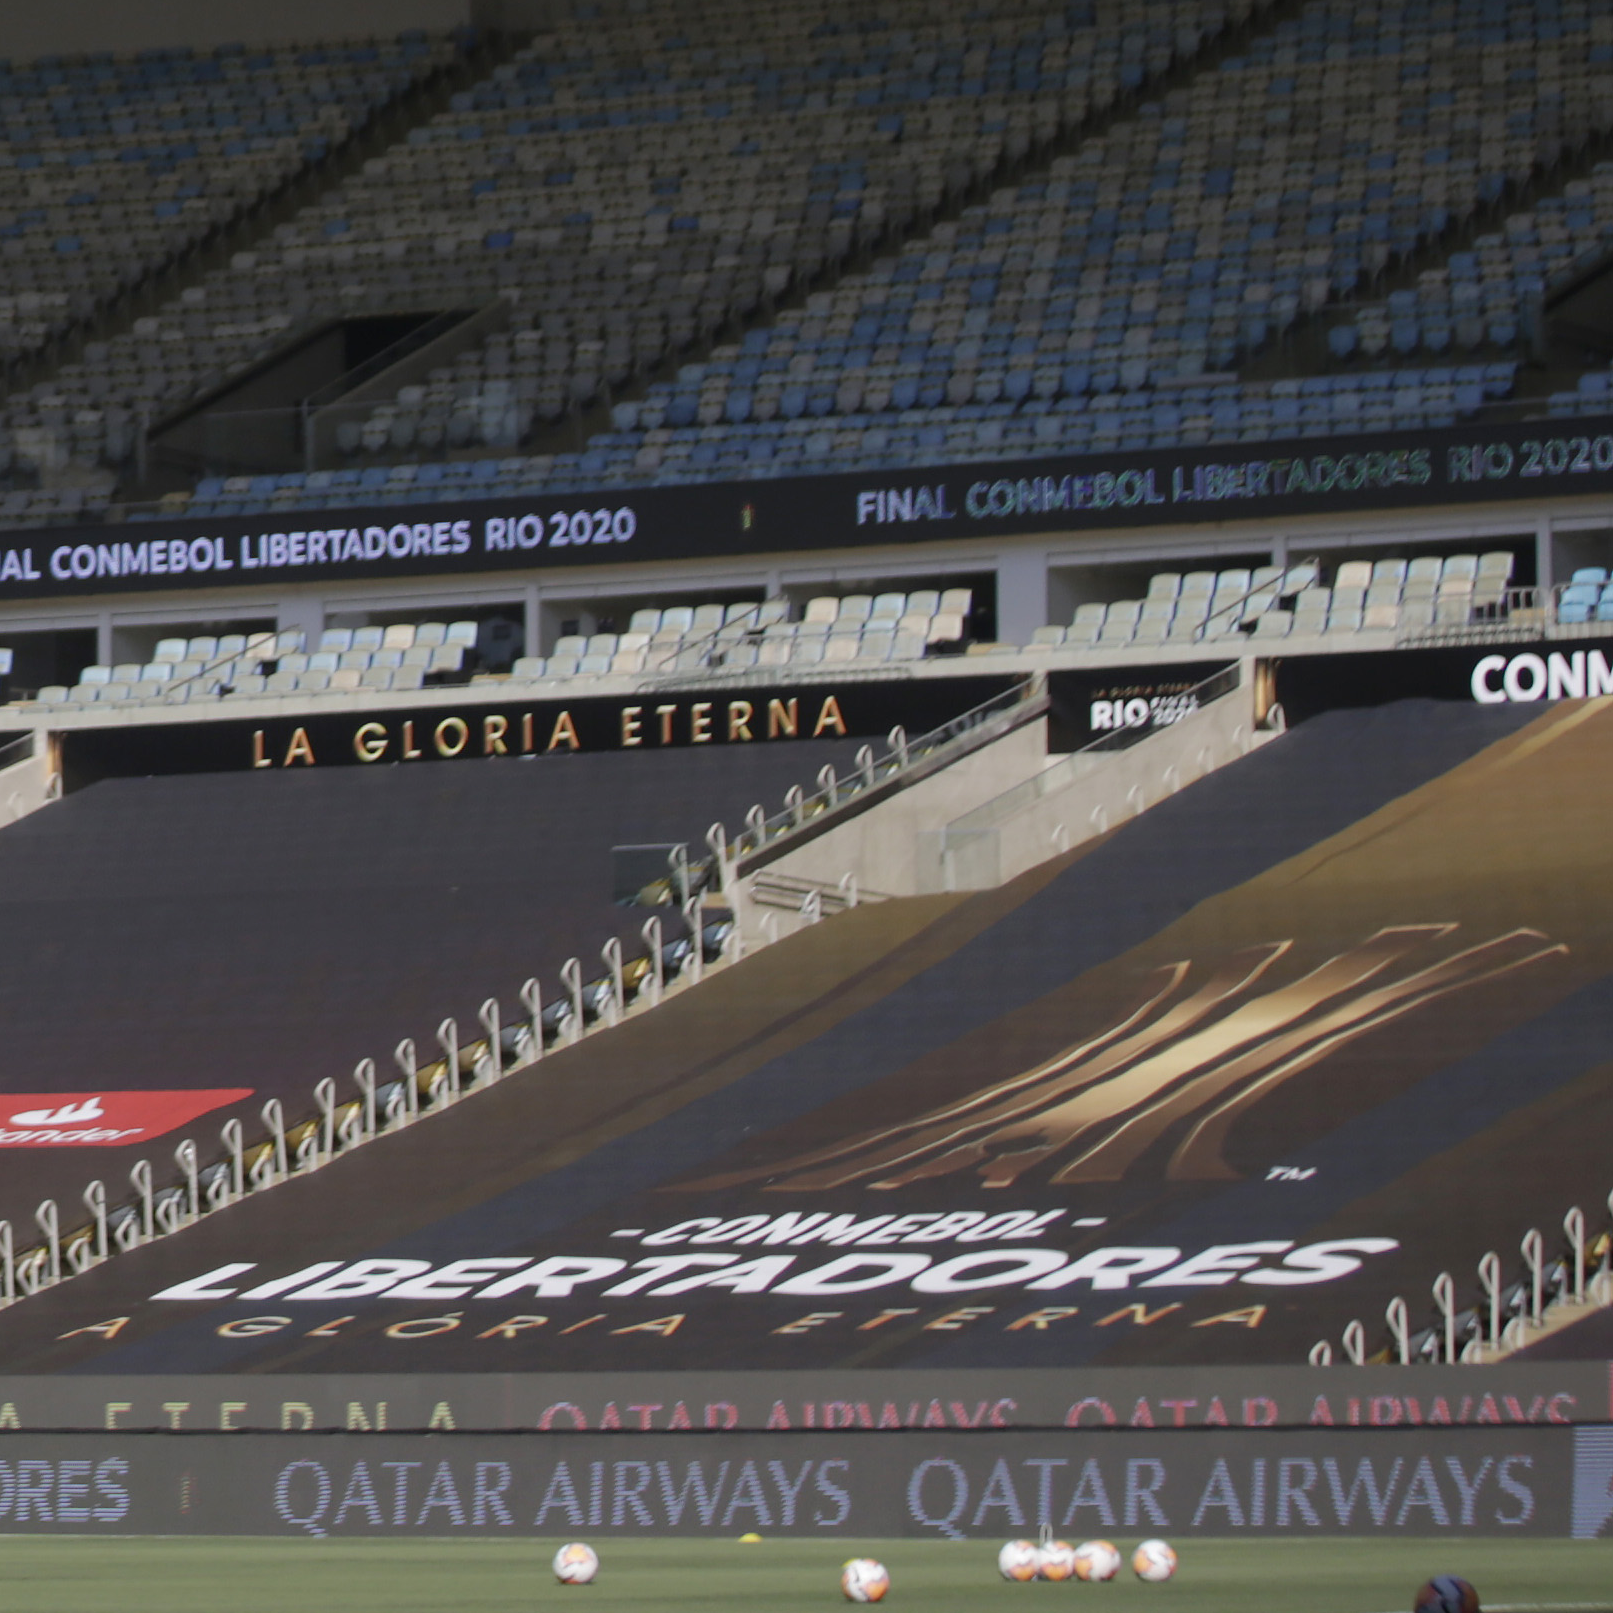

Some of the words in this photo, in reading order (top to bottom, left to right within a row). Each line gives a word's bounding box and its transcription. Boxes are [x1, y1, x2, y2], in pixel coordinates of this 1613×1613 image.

[857, 485, 956, 524] FINAL
[966, 468, 1163, 518] CONMEBOL
[1173, 449, 1431, 501] LIBERTADORES
[1447, 444, 1512, 483] RIO
[1519, 435, 1613, 477] 2020
[50, 536, 232, 578] CONMEBOL
[241, 521, 471, 566] LIBERTADORES
[485, 515, 543, 549] RIO
[549, 507, 636, 542] 2020
[253, 726, 315, 769] LA
[354, 710, 579, 763] GLORIA
[622, 695, 846, 747] ETERNA
[1090, 697, 1151, 729] RIO
[640, 1209, 1067, 1246] CONMEBOL
[150, 1238, 1400, 1301] LIBERTADORES
[772, 1305, 1267, 1334] ETERNA
[274, 1458, 515, 1538] QATAR
[532, 1458, 851, 1527] AIRWAYS
[905, 1456, 1170, 1541] QATAR
[1190, 1454, 1534, 1527] AIRWAYS
